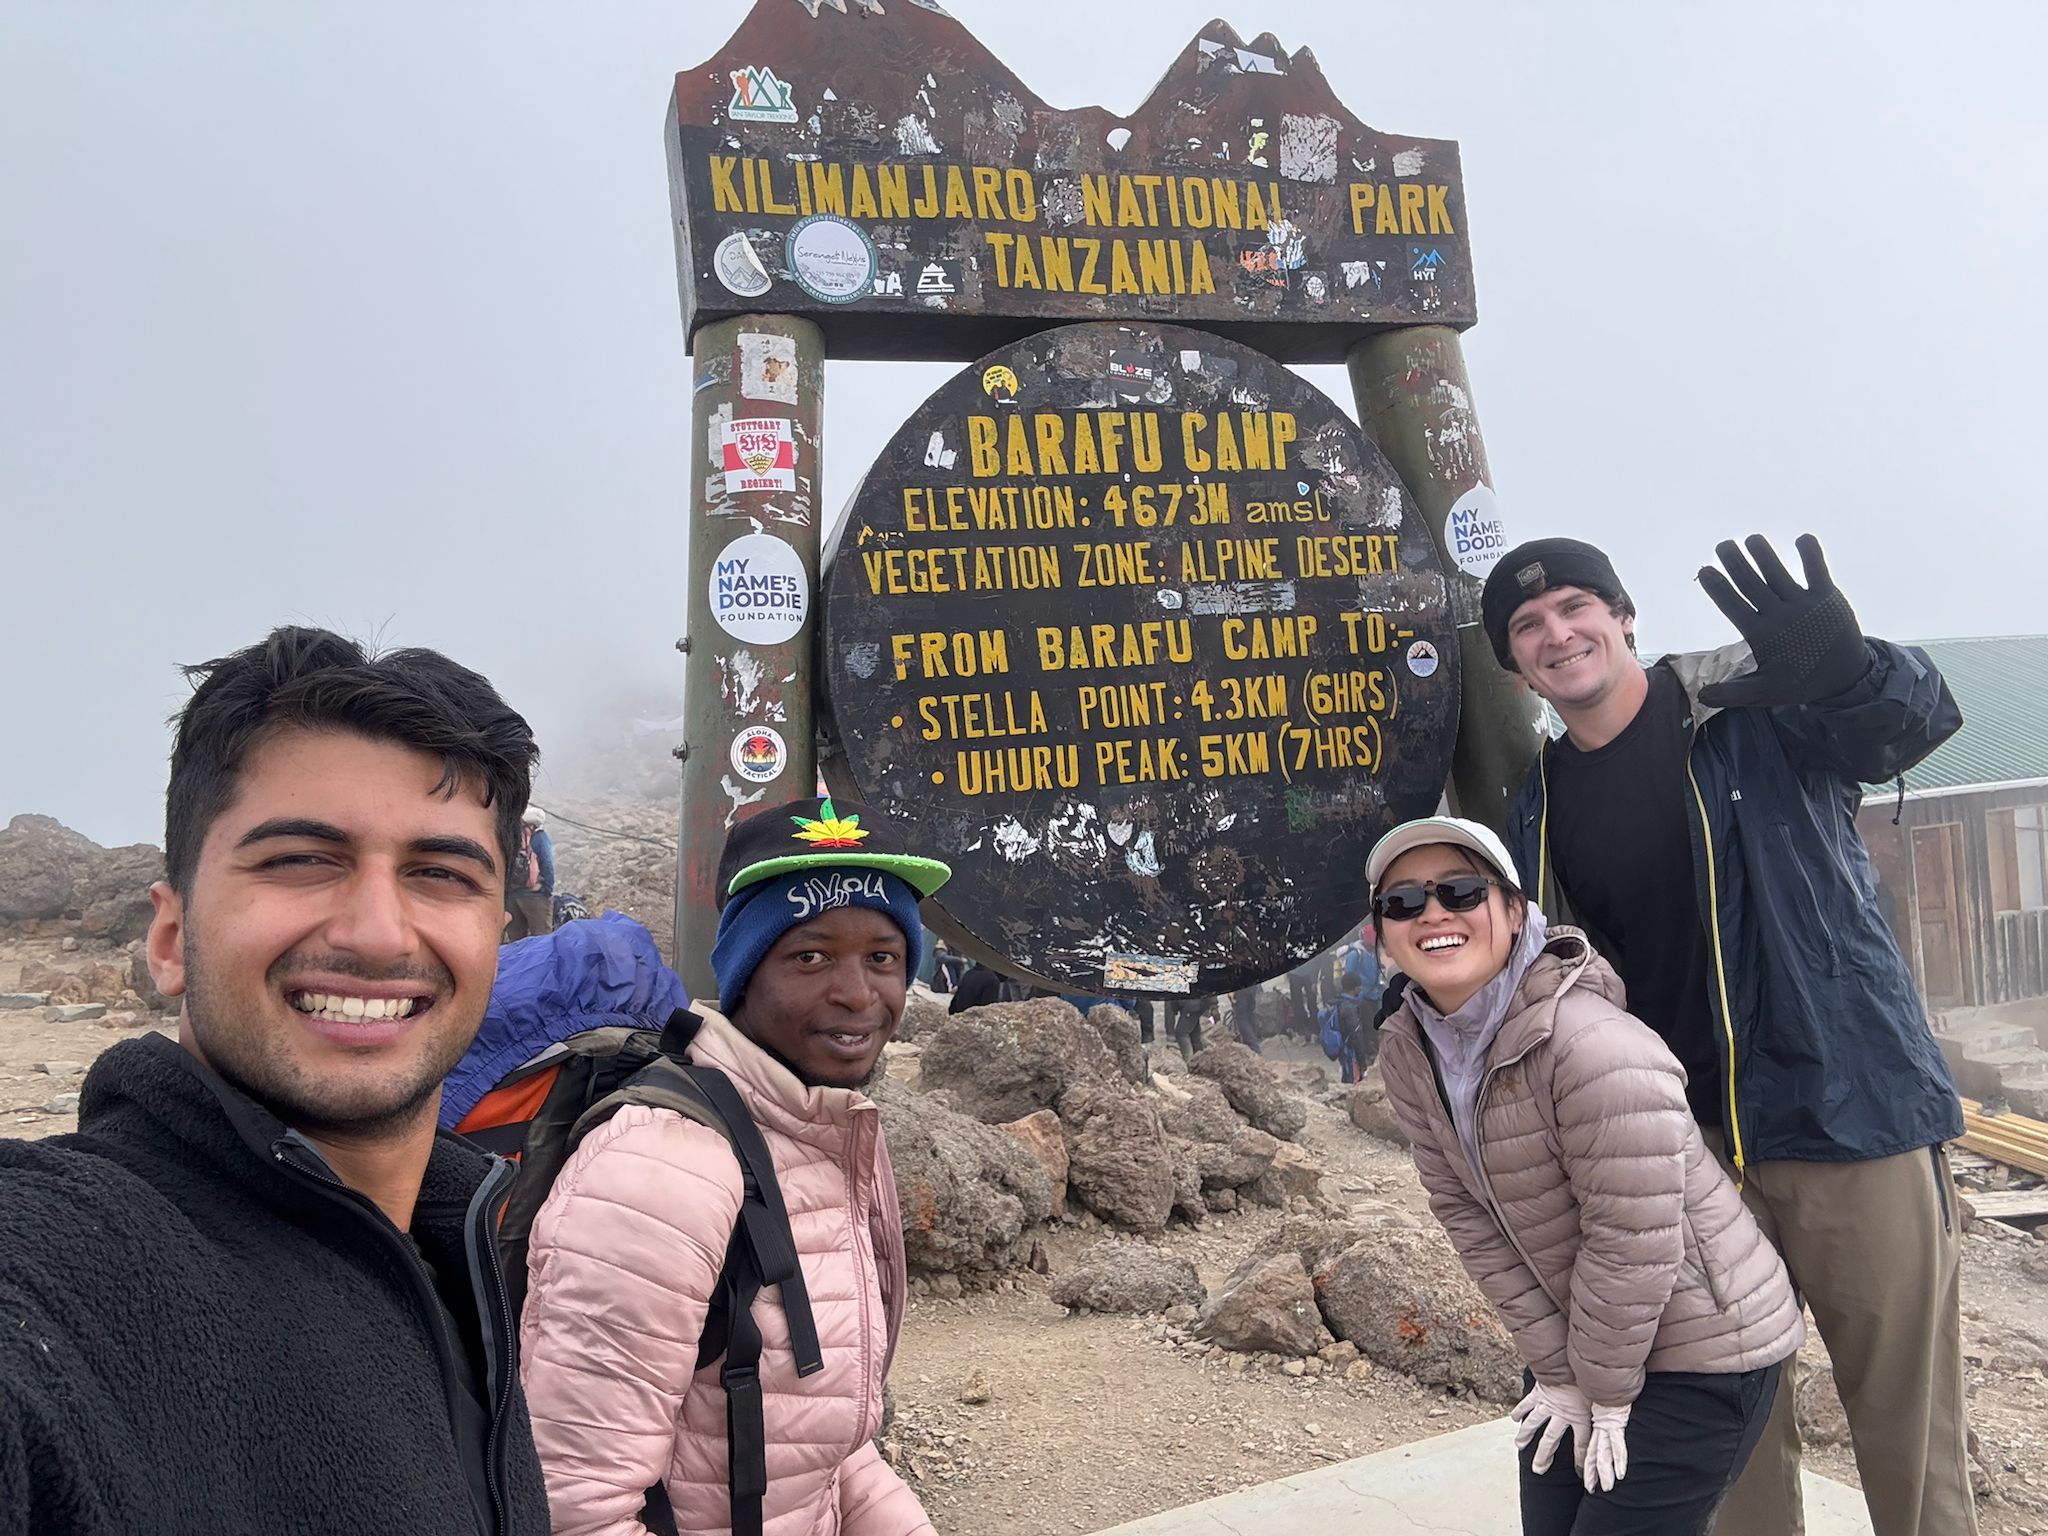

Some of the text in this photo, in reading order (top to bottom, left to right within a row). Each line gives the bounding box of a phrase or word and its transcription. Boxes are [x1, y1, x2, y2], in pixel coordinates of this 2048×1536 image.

[709, 154, 1038, 223] KILIMANJARO
[1349, 182, 1455, 235] PARK
[984, 231, 1217, 296] TANZANIA
[730, 421, 781, 432] STUTTGART
[967, 411, 1298, 478] BARAFU CAMP
[740, 479, 783, 489] REGIERT!
[903, 482, 1331, 532] ELEVATION: 4673M amsl
[1452, 508, 1478, 525] MY
[718, 559, 749, 576] MY
[862, 534, 1399, 595] VEGETATION ZONE: ALPINE DESERT
[719, 575, 797, 592] NAME'S
[719, 593, 801, 609] DODDIE
[720, 612, 802, 623] FOUNDATION
[891, 629, 1009, 680] FROM
[1036, 619, 1193, 671] BARAFU
[1222, 615, 1318, 661] CAMP
[918, 666, 1398, 741] STELLA POINT: 4.3KM (6HRS)
[747, 730, 772, 738] ALOHA
[957, 715, 1383, 796] UHURU PEAK: 5KM (7HRS)
[743, 768, 777, 779] TACTICAL
